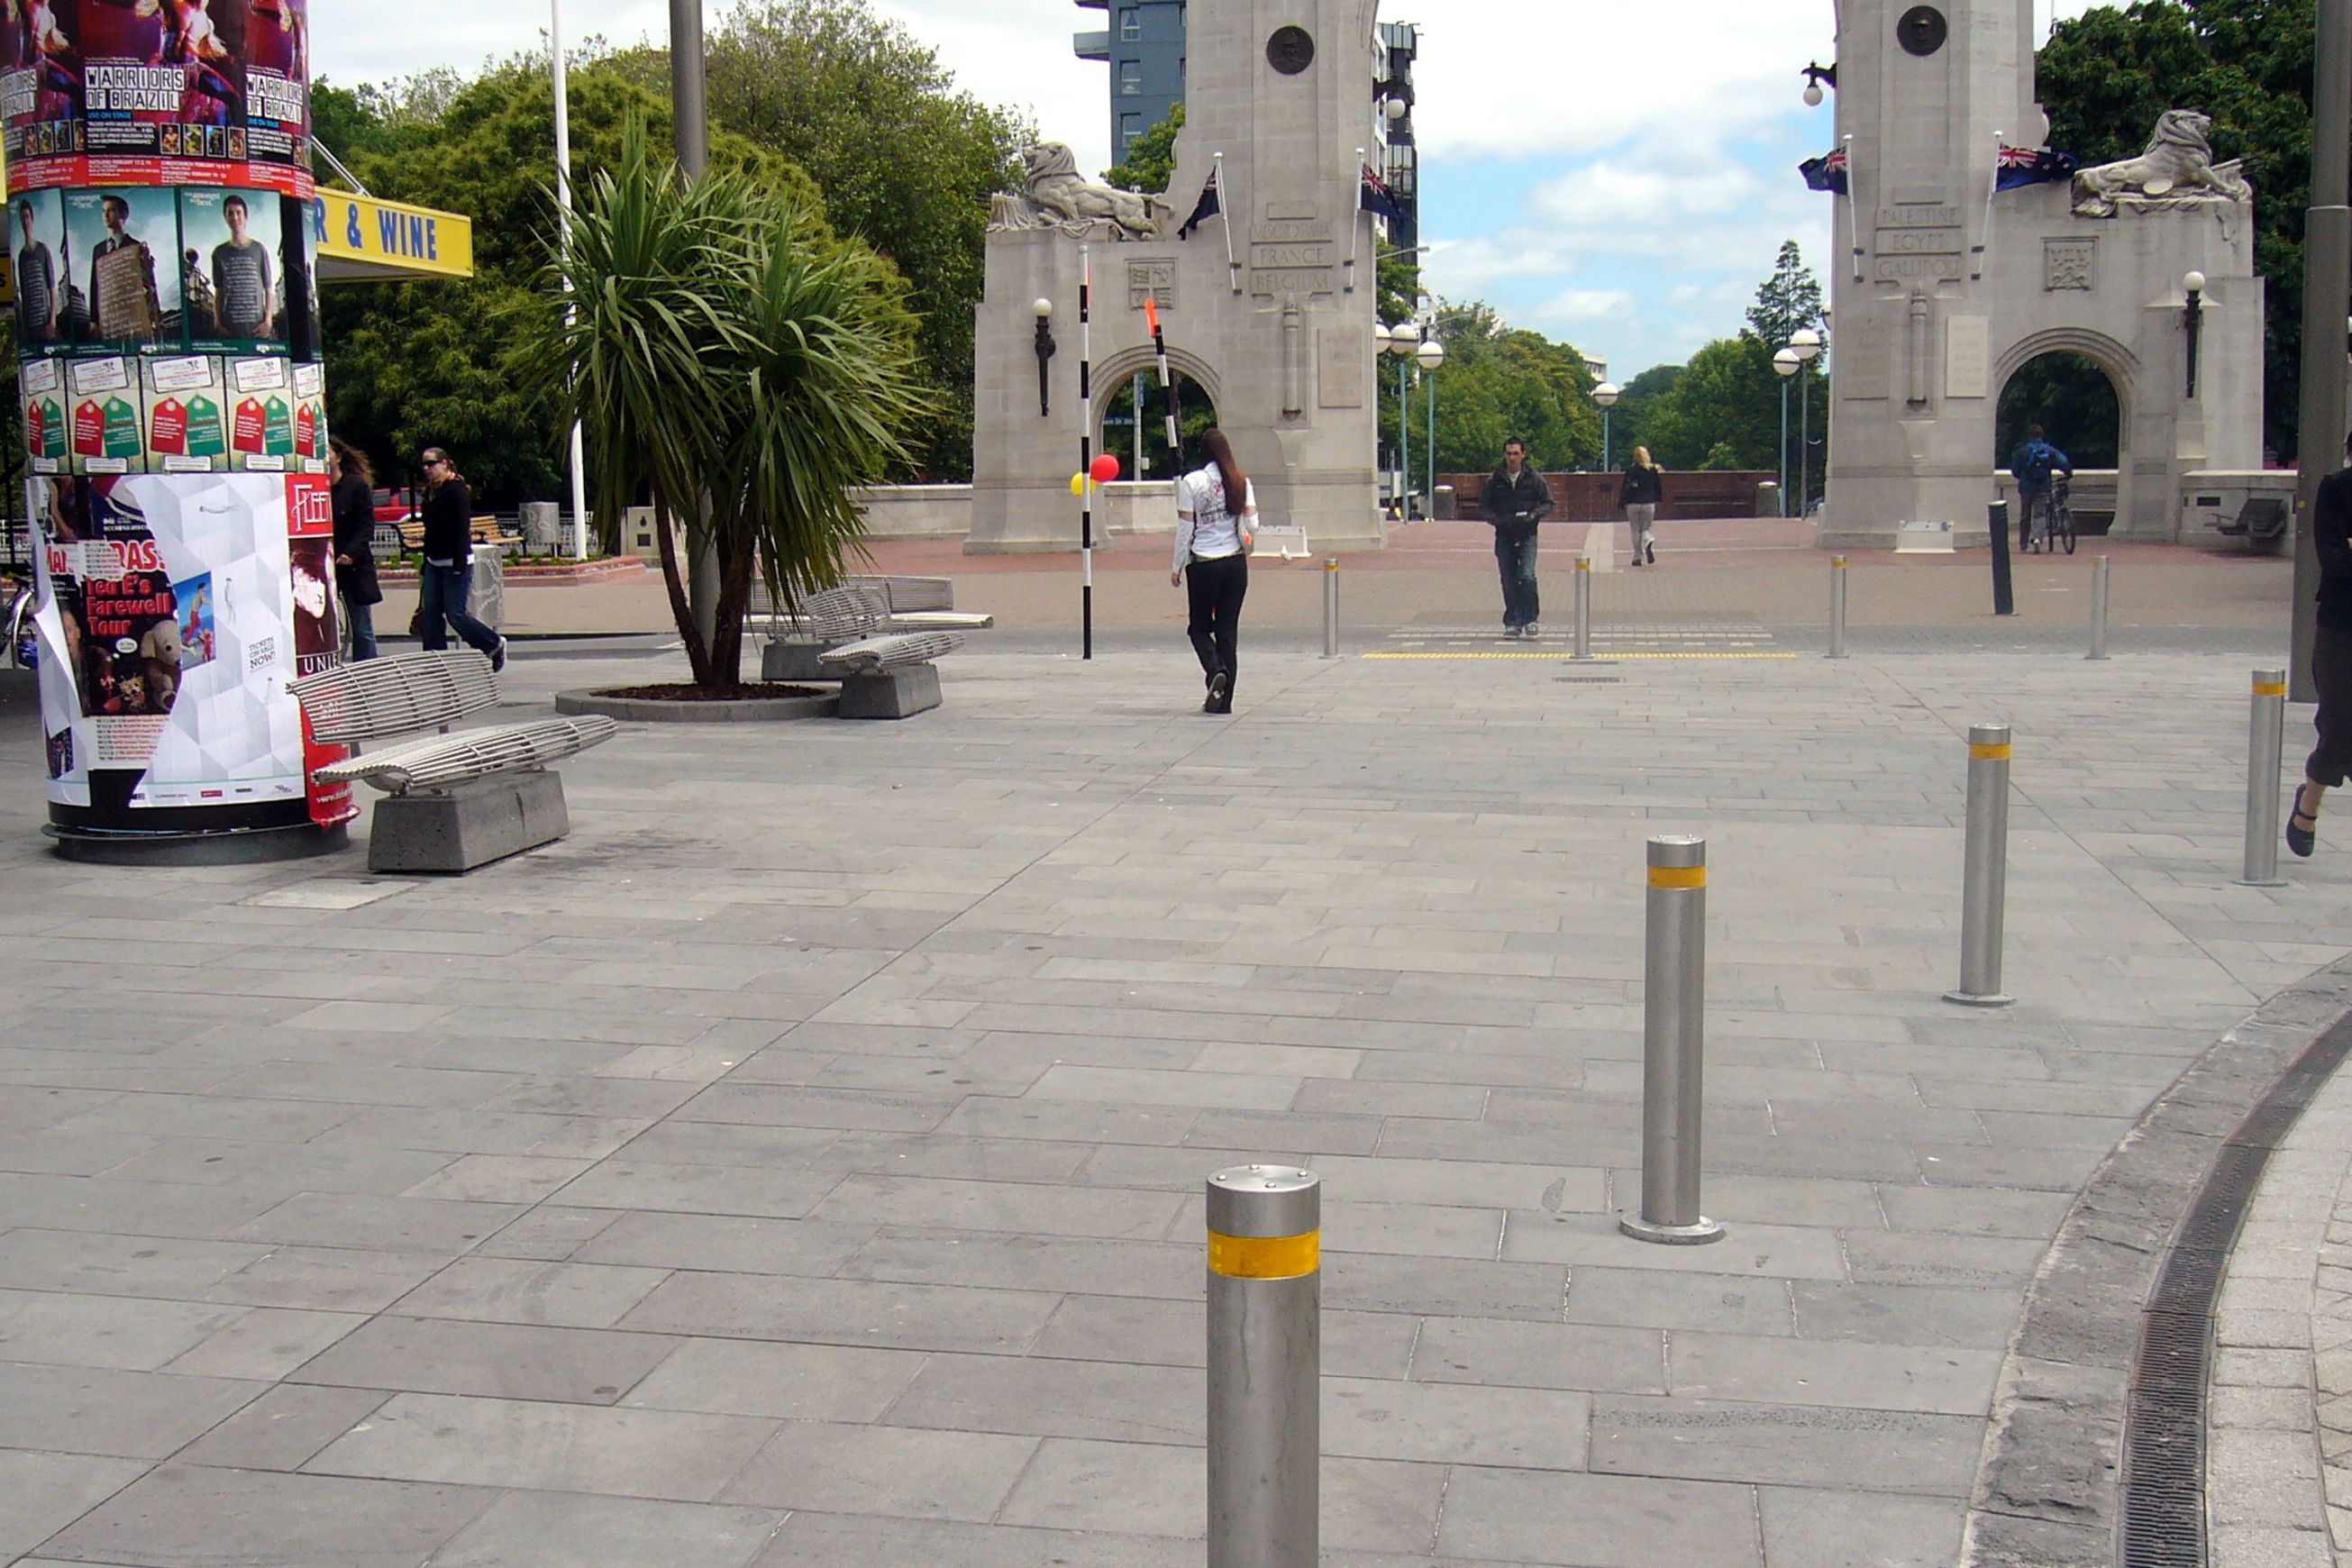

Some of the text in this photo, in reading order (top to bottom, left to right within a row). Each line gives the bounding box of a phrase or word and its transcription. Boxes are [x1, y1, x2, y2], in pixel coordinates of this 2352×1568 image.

[87, 68, 184, 89] WARRIORS
[87, 90, 179, 111] OF BRAZIL
[247, 96, 262, 115] OF
[347, 203, 362, 249] &
[378, 208, 437, 261] WINE
[1260, 247, 1324, 265] FRANCE
[1255, 273, 1328, 290] BELGIUM
[87, 592, 171, 615] Farewell
[87, 615, 132, 636] Tour
